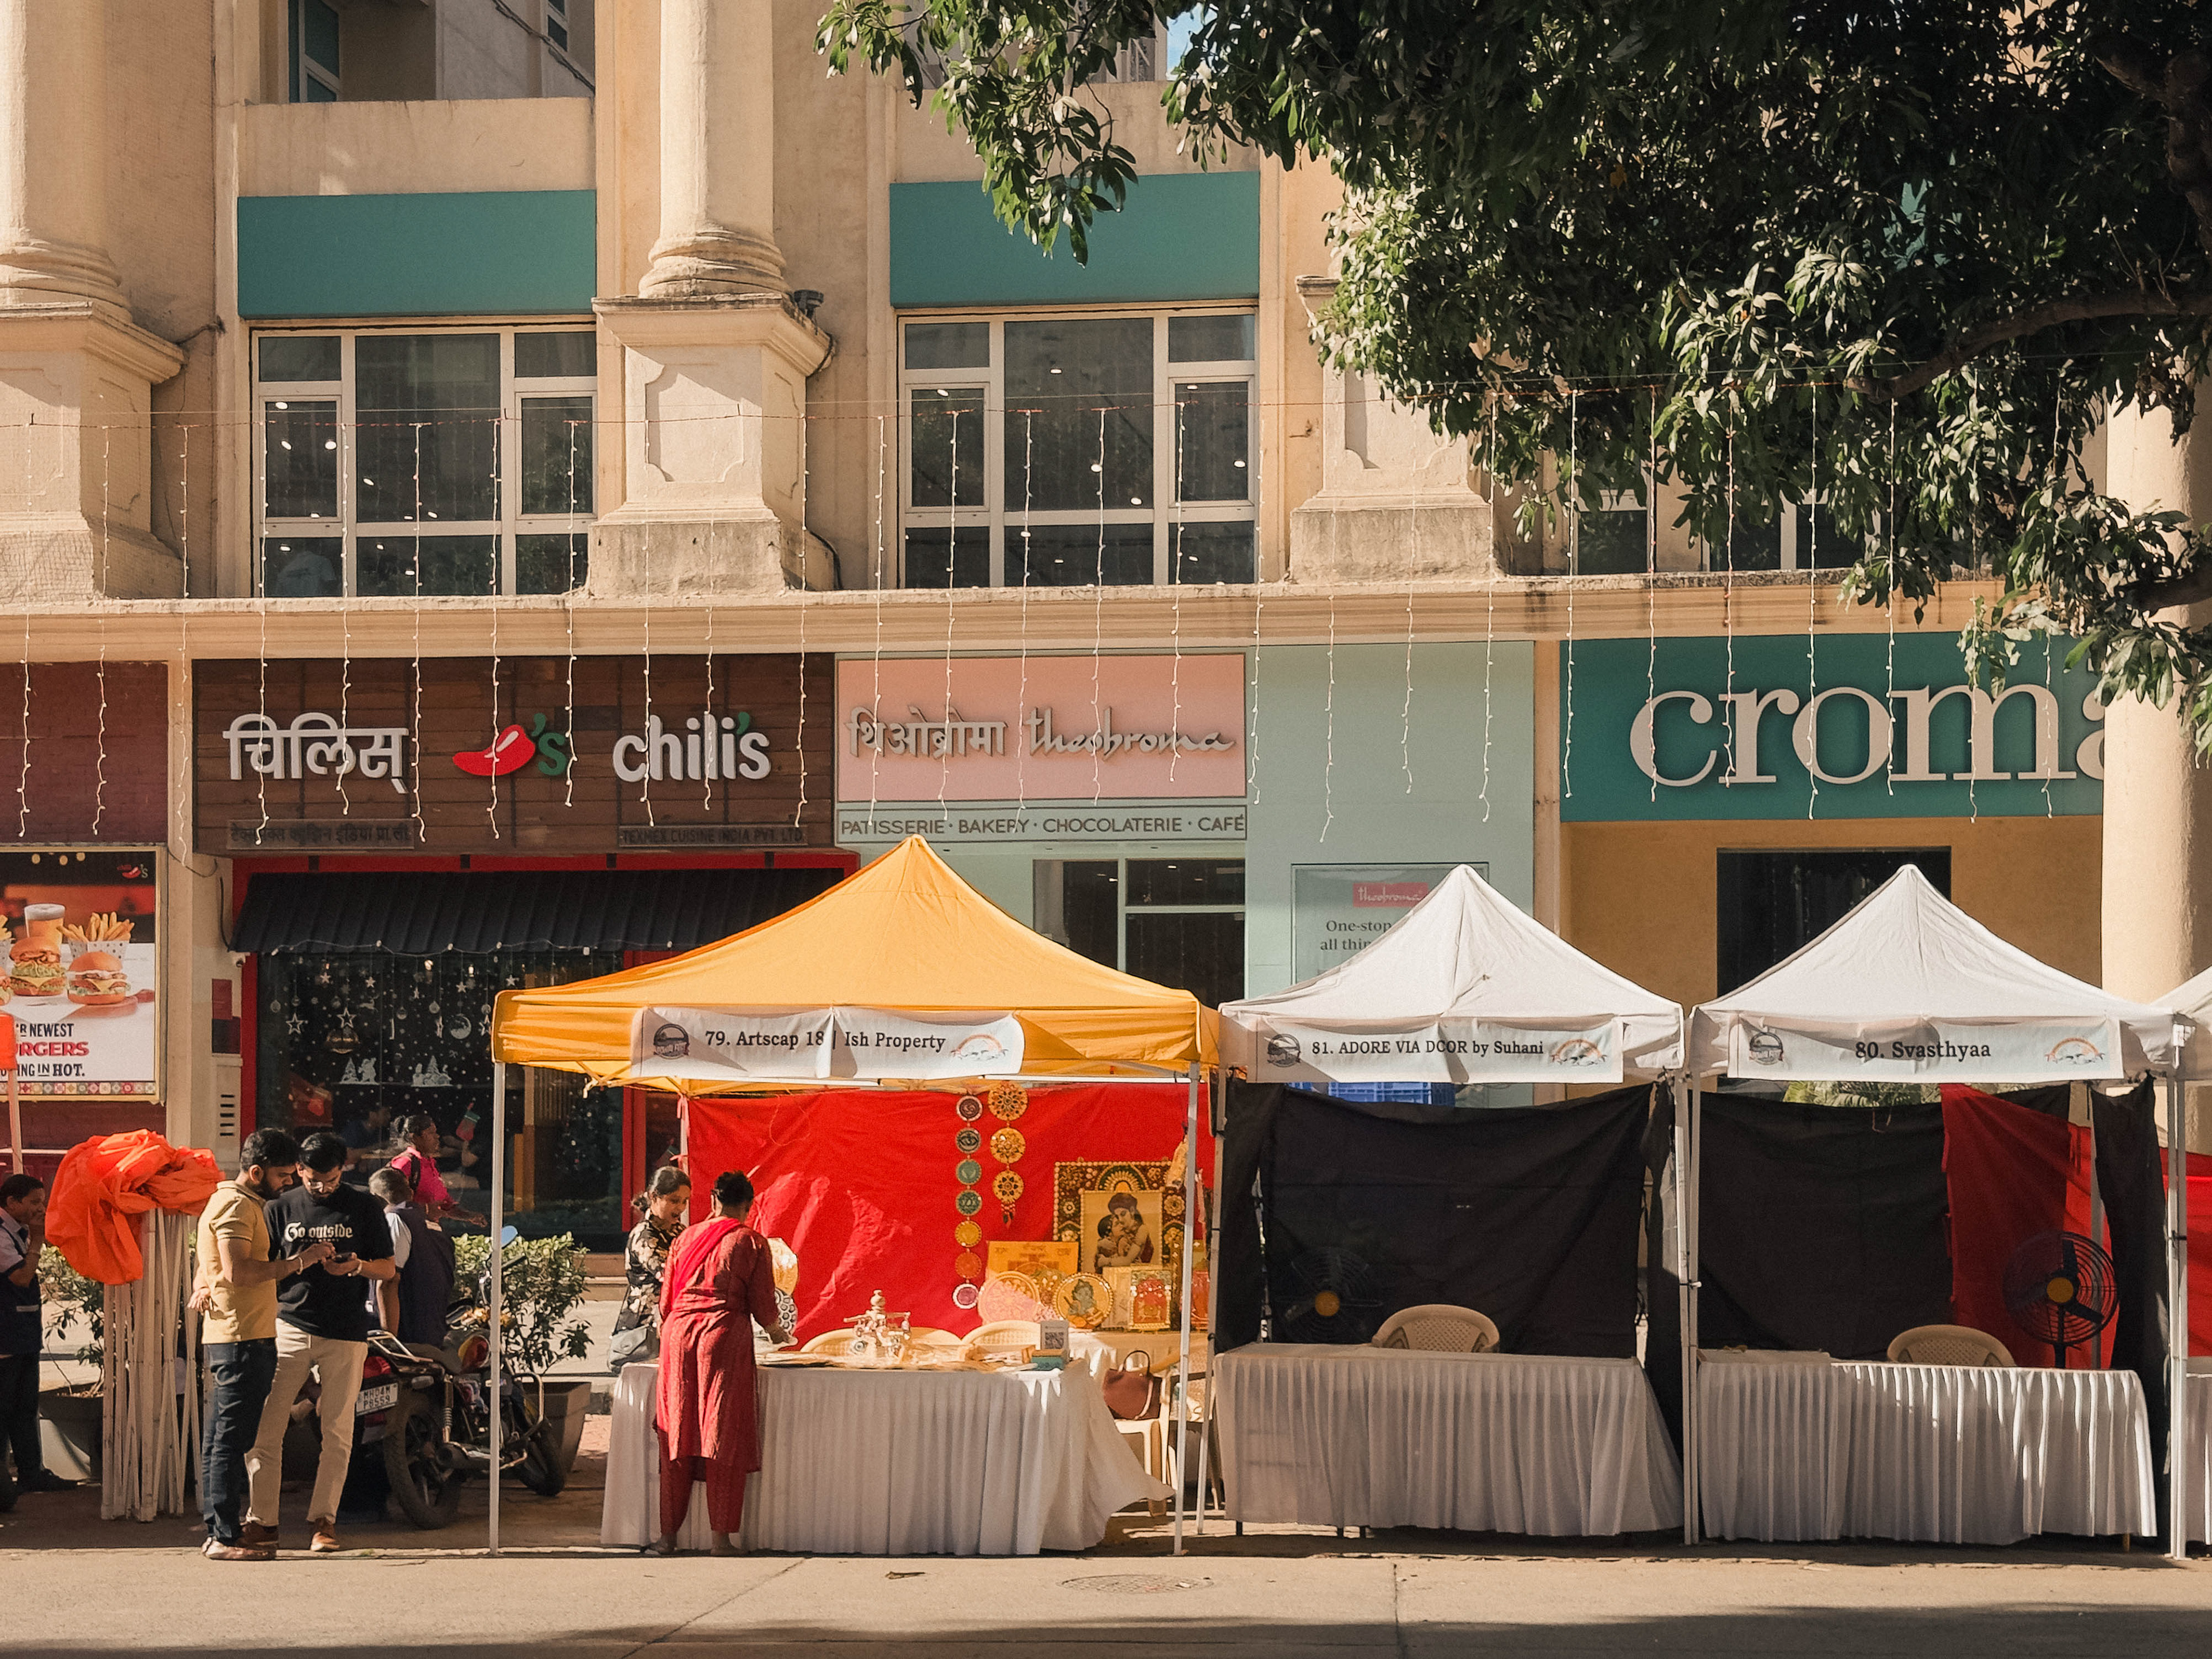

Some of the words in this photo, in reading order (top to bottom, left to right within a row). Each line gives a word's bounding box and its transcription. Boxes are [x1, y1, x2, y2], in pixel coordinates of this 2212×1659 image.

[1025, 706, 1236, 762] theobroma
[222, 712, 409, 794] चिलिस्
[612, 712, 771, 782] chili's
[841, 820, 945, 834] PATISSERIE
[959, 819, 1029, 834] BAKERY
[1043, 817, 1183, 832] CHOCOLATERIE
[1198, 813, 1245, 831] CAFÉ
[1326, 920, 1392, 933] One-stop
[1320, 938, 1337, 950] all
[29, 1023, 74, 1037] NEWEST
[16, 1041, 89, 1056] RGERS
[704, 1030, 730, 1047] 79.
[736, 1031, 799, 1050] Artscap
[806, 1031, 824, 1047] 18
[844, 1030, 869, 1047] Ish
[875, 1032, 946, 1052] Property
[1312, 1041, 1334, 1055] 81.
[1339, 1040, 1391, 1054] ADORE
[1396, 1040, 1421, 1054] VIA
[1472, 1040, 1489, 1058] by
[1494, 1040, 1544, 1055] Suhani
[1855, 1041, 1885, 1059] 80.
[1892, 1041, 1991, 1062] Svasthyaa
[38, 1063, 50, 1075] IN
[52, 1064, 85, 1077] HOT.
[284, 1222, 306, 1242] Go
[309, 1224, 353, 1238] outside
